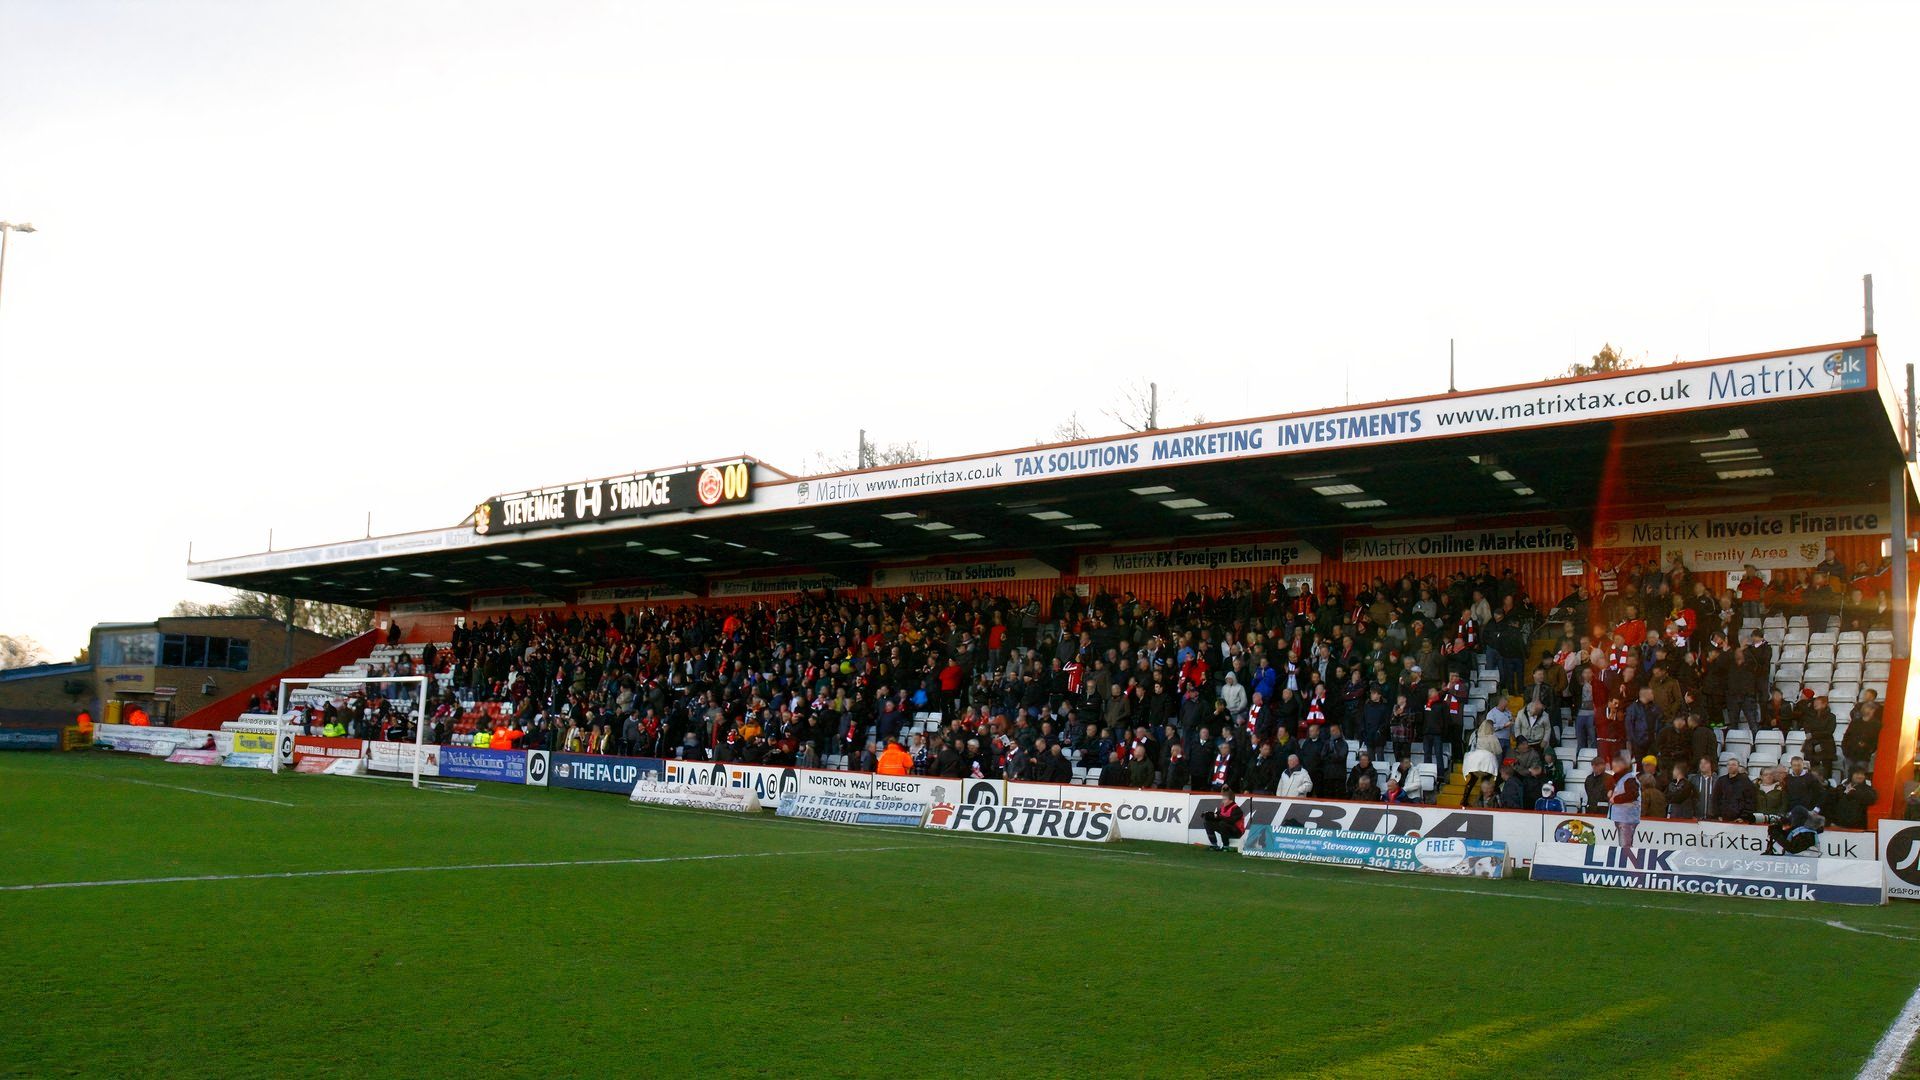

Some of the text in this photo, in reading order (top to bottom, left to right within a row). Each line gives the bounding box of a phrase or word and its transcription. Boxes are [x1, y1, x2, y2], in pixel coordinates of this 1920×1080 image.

[1437, 379, 1690, 426] www.matrixtax.co.uk
[1708, 361, 1815, 399] Matrix
[1015, 409, 1421, 476] TAX SOLUTIONS MARKETING INVESTMENTS
[724, 463, 748, 499] 00
[816, 463, 1002, 502] Matrix www.matrixtax.co.uk
[503, 492, 565, 526] STEVENAGE
[610, 476, 670, 512] S'BRIDGE
[1632, 511, 1879, 544] Matrix Invoice Finance
[1363, 527, 1576, 557] Matrix Online Marketing
[1113, 544, 1299, 570] Matrix FX Foreign Exchange
[1694, 547, 1788, 563] Family Area
[965, 563, 1016, 580] Solutions
[532, 759, 545, 774] JD
[571, 762, 637, 783] THE FA CUP
[766, 774, 778, 799] @
[808, 775, 921, 793] NORTON WAY PEUGEOT
[819, 797, 871, 809] TECHNICAL
[874, 801, 927, 812] SUPPORT
[974, 790, 995, 805] JD
[953, 805, 1114, 840] FORTRUS
[1117, 803, 1183, 824] CO.UK
[1272, 826, 1418, 846] Walton Lodge Veterinary Group
[1426, 839, 1455, 852] FREE
[1321, 841, 1371, 854] Stevenage
[1376, 846, 1412, 860] 01438
[1368, 856, 1416, 872] 364 354
[1584, 844, 1810, 875] LINK CCTV SYSTEMS
[1582, 870, 1817, 901] www.linkcctv.co.uk
